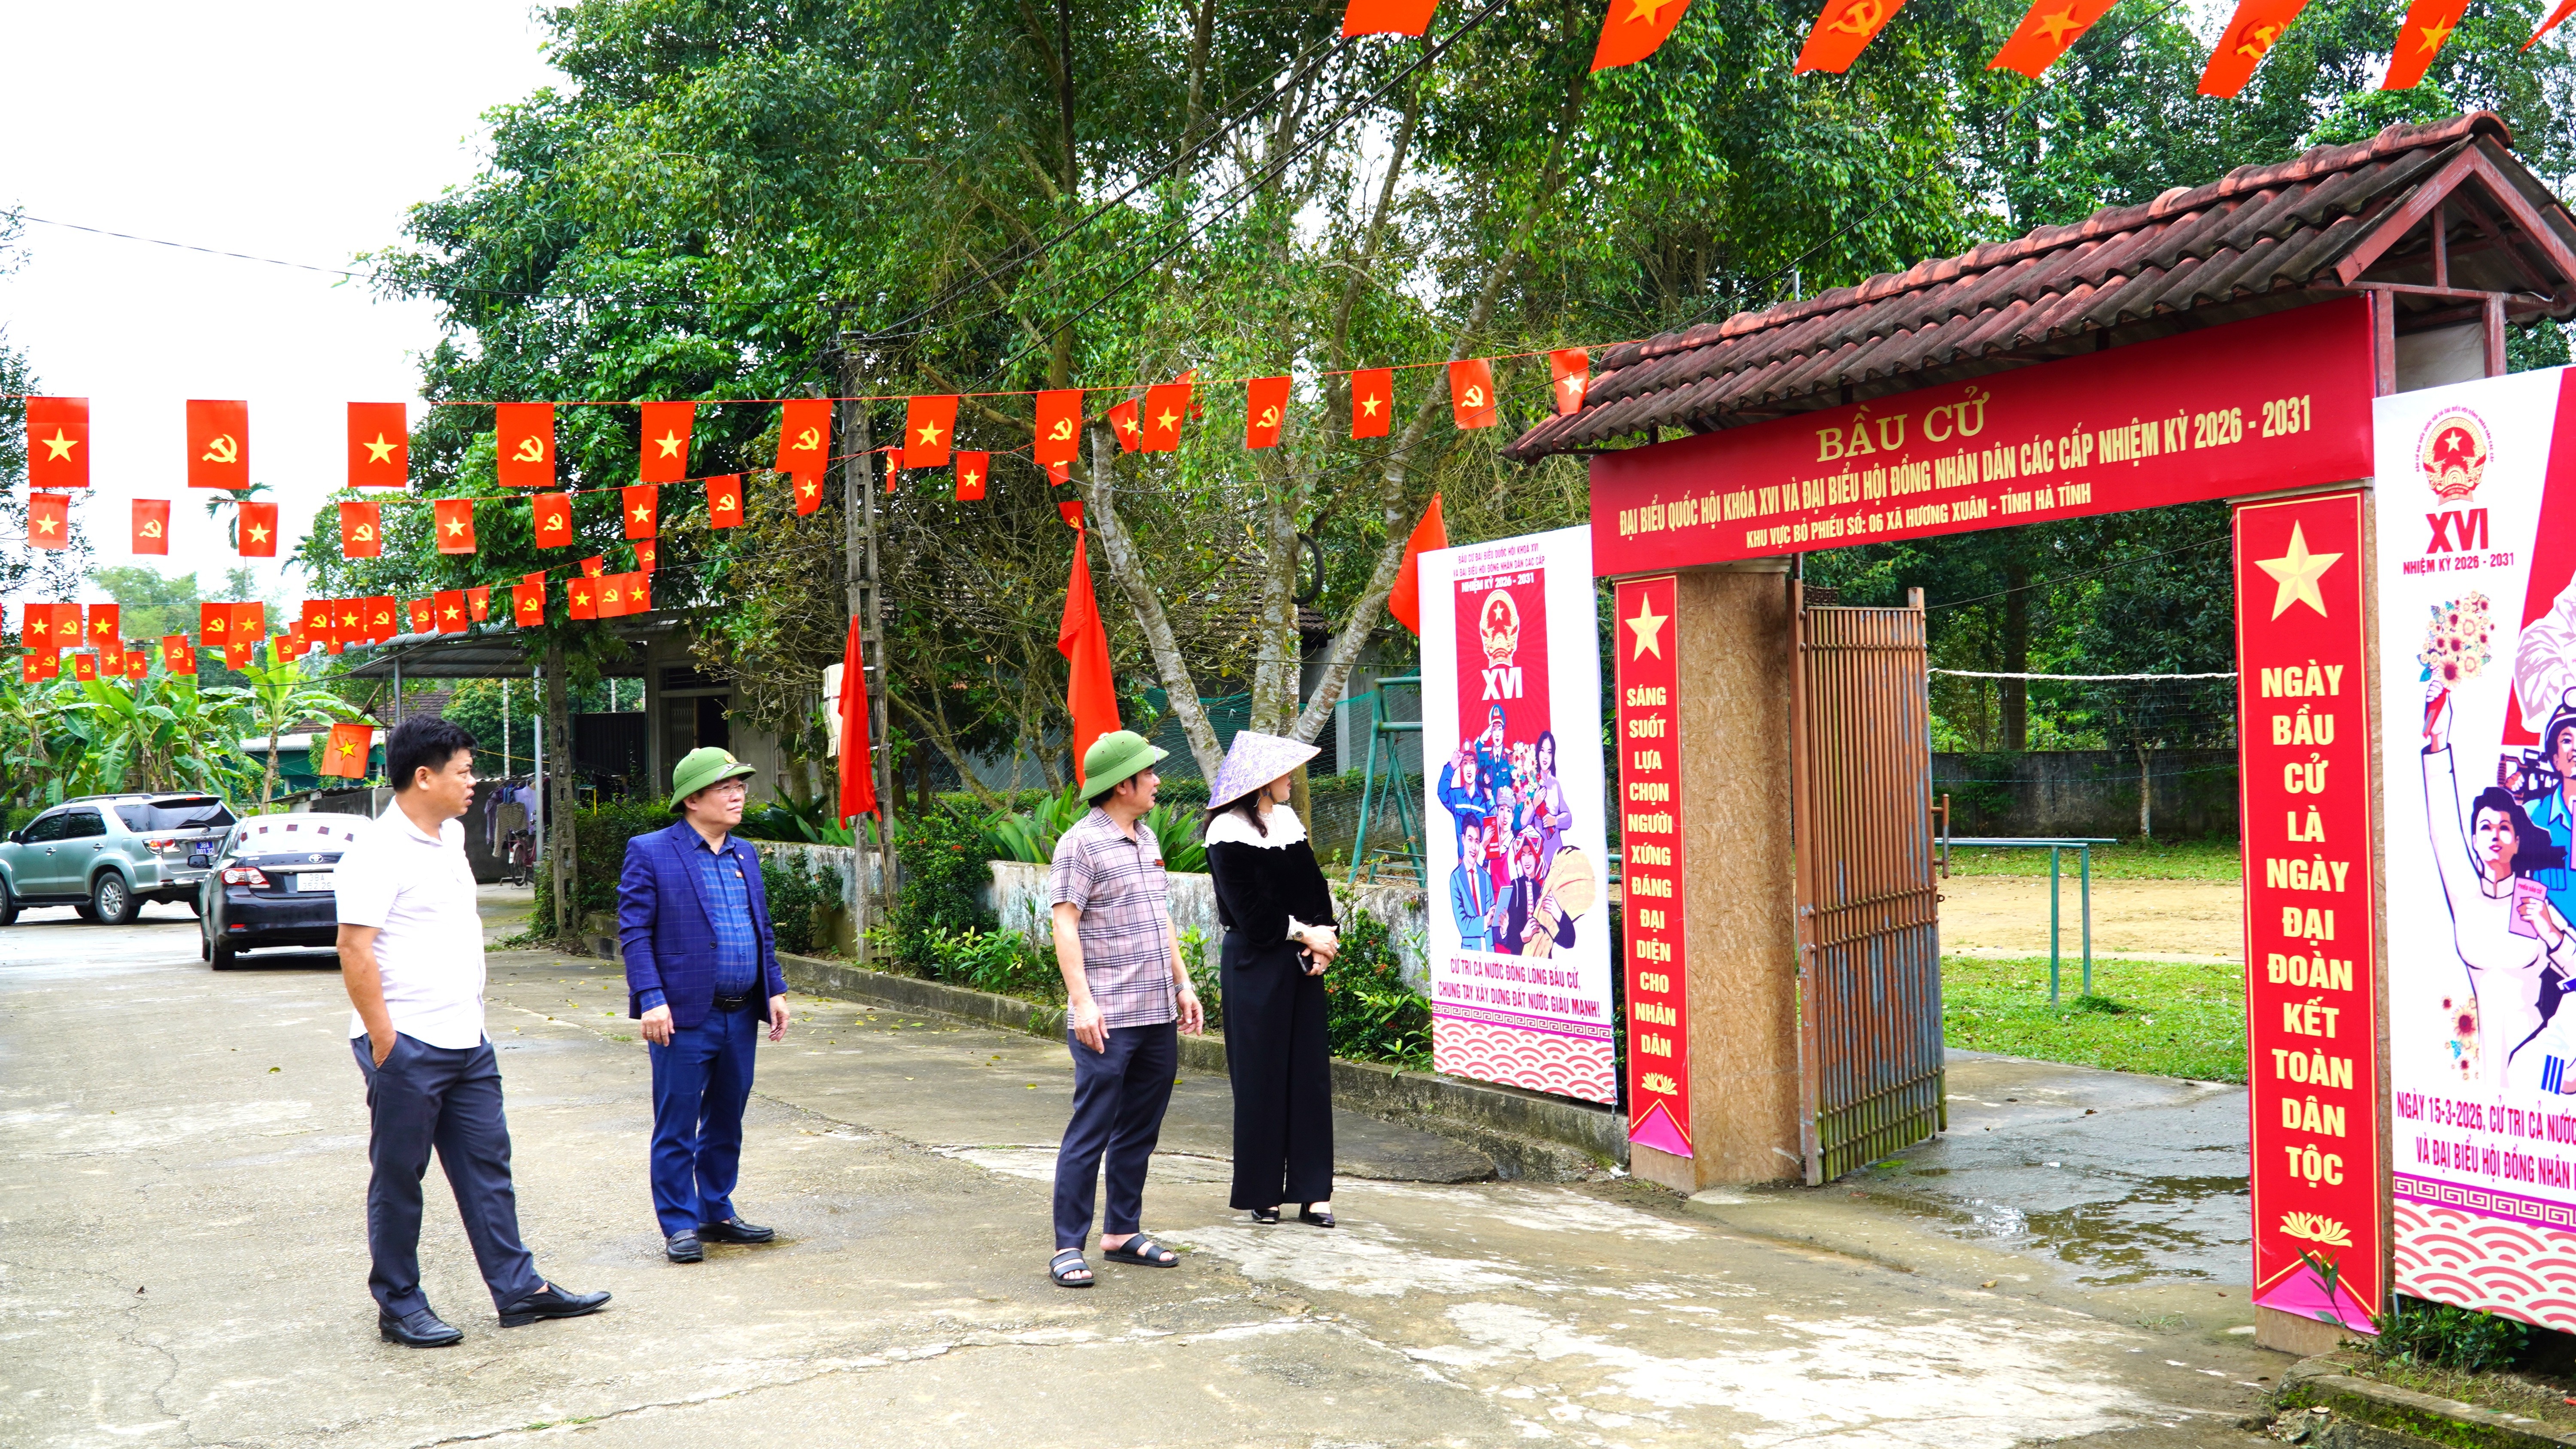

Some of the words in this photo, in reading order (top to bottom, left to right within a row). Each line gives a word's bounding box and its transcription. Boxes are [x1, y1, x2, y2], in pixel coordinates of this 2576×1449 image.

[1816, 404, 1908, 462] BẦU
[1924, 386, 1990, 442] CỬ
[1620, 509, 1637, 540] ĐẠI
[1640, 494, 1665, 533] BIỂU
[1668, 490, 1698, 531] QUỐC
[1701, 490, 1720, 529] HỘI
[1723, 485, 1756, 521] KHÓA
[1759, 485, 1779, 516] XVI
[1782, 477, 1800, 512] VÀ
[1802, 478, 1825, 514] ĐẠI
[1828, 461, 1859, 506] BIỂU
[1863, 463, 1887, 506] HỘI
[1890, 453, 1931, 496] ĐỒNG
[1935, 448, 1978, 489] NHÂN
[1983, 441, 2016, 482] DÂN
[2020, 434, 2054, 476] CÁC
[2059, 422, 2093, 470] CẤP
[2099, 417, 2159, 467] NHIỆM
[2164, 409, 2189, 454] KỲ
[2194, 407, 2242, 449] 2026
[2248, 421, 2256, 429] -
[2262, 394, 2310, 438] 2031
[1746, 529, 1768, 549] KHU
[1769, 524, 1791, 549] VỰC
[1793, 517, 1808, 543] BỎ
[1811, 513, 1844, 540] PHIẾU
[1847, 509, 1866, 535] SỐ:
[1869, 513, 1883, 533] 06
[1886, 506, 1903, 530] XÃ
[1906, 503, 1948, 528] HƯƠNG
[1952, 495, 1987, 521] XUÂN
[1999, 487, 2032, 515] TỈNH
[2035, 484, 2055, 510] HÀ
[2057, 481, 2091, 507] TĨNH
[2425, 508, 2488, 554] XVI
[2403, 557, 2435, 576] NHIỆM
[2439, 555, 2451, 572] KỲ
[2454, 555, 2479, 570] 2026
[2490, 552, 2514, 567] 2031
[1461, 578, 1483, 594] NHIỆM
[1484, 576, 1493, 589] KỲ
[1495, 576, 1512, 588] 2026
[1517, 573, 1534, 585] 2031
[1481, 667, 1523, 700] XVI
[1627, 684, 1666, 707] SÁNG
[2260, 659, 2344, 698] NGÀY
[1629, 712, 1666, 738] SUỐT
[2272, 704, 2335, 746] BẦU
[1634, 749, 1662, 773] LỰA
[2284, 752, 2329, 794] CỬ
[1629, 782, 1669, 806] CHỌN
[1628, 810, 1673, 834] NGƯỜI
[2287, 805, 2326, 843] LÀ
[1631, 843, 1671, 867] XỨNG
[2266, 854, 2350, 892] NGÀY
[1631, 875, 1672, 898] ĐÁNG
[1640, 909, 1665, 932] ĐẠI
[2282, 906, 2334, 946] ĐẠI
[1636, 938, 1671, 964] DIỆN
[1451, 954, 1459, 974] CỬ
[1461, 959, 1471, 976] TRI
[1474, 956, 1482, 977] CẢ
[1485, 960, 1503, 979] NƯỚC
[1506, 960, 1525, 982] ĐỒNG
[1528, 964, 1546, 985] LÒNG
[1549, 965, 1564, 988] BẦU
[1567, 967, 1580, 991] CỬ,
[1640, 971, 1669, 994] CHO
[2267, 950, 2353, 991] ĐOÀN
[1438, 981, 1460, 998] CHUNG
[1462, 985, 1473, 1000] TAY
[1476, 983, 1488, 1003] XÂY
[1491, 987, 1510, 1008] DỰNG
[1512, 986, 1525, 1008] ĐẤT
[1528, 991, 1548, 1011] NƯỚC
[1551, 993, 1569, 1014] GIÀU
[1572, 998, 1601, 1020] MẠNH!
[1635, 1001, 1676, 1027] NHÂN
[2283, 996, 2339, 1039] KẾT
[1641, 1034, 1671, 1058] DÂN
[2272, 1048, 2353, 1090] TOÀN
[2281, 1095, 2345, 1138] DÂN
[2397, 1088, 2424, 1121] NGÀY
[2429, 1097, 2485, 1134] 15-3-2026,
[2490, 1094, 2505, 1134] CỬ
[2507, 1108, 2524, 1137] TRI
[2529, 1100, 2543, 1140] CẢ
[2285, 1143, 2343, 1188] TỘC
[2416, 1132, 2430, 1164] VÀ
[2433, 1139, 2450, 1173] ĐẠI
[2454, 1134, 2478, 1173] BIỂU
[2482, 1143, 2500, 1182] HỘI
[2504, 1144, 2534, 1183] ĐỒNG
[2538, 1154, 2570, 1189] NHÂN
